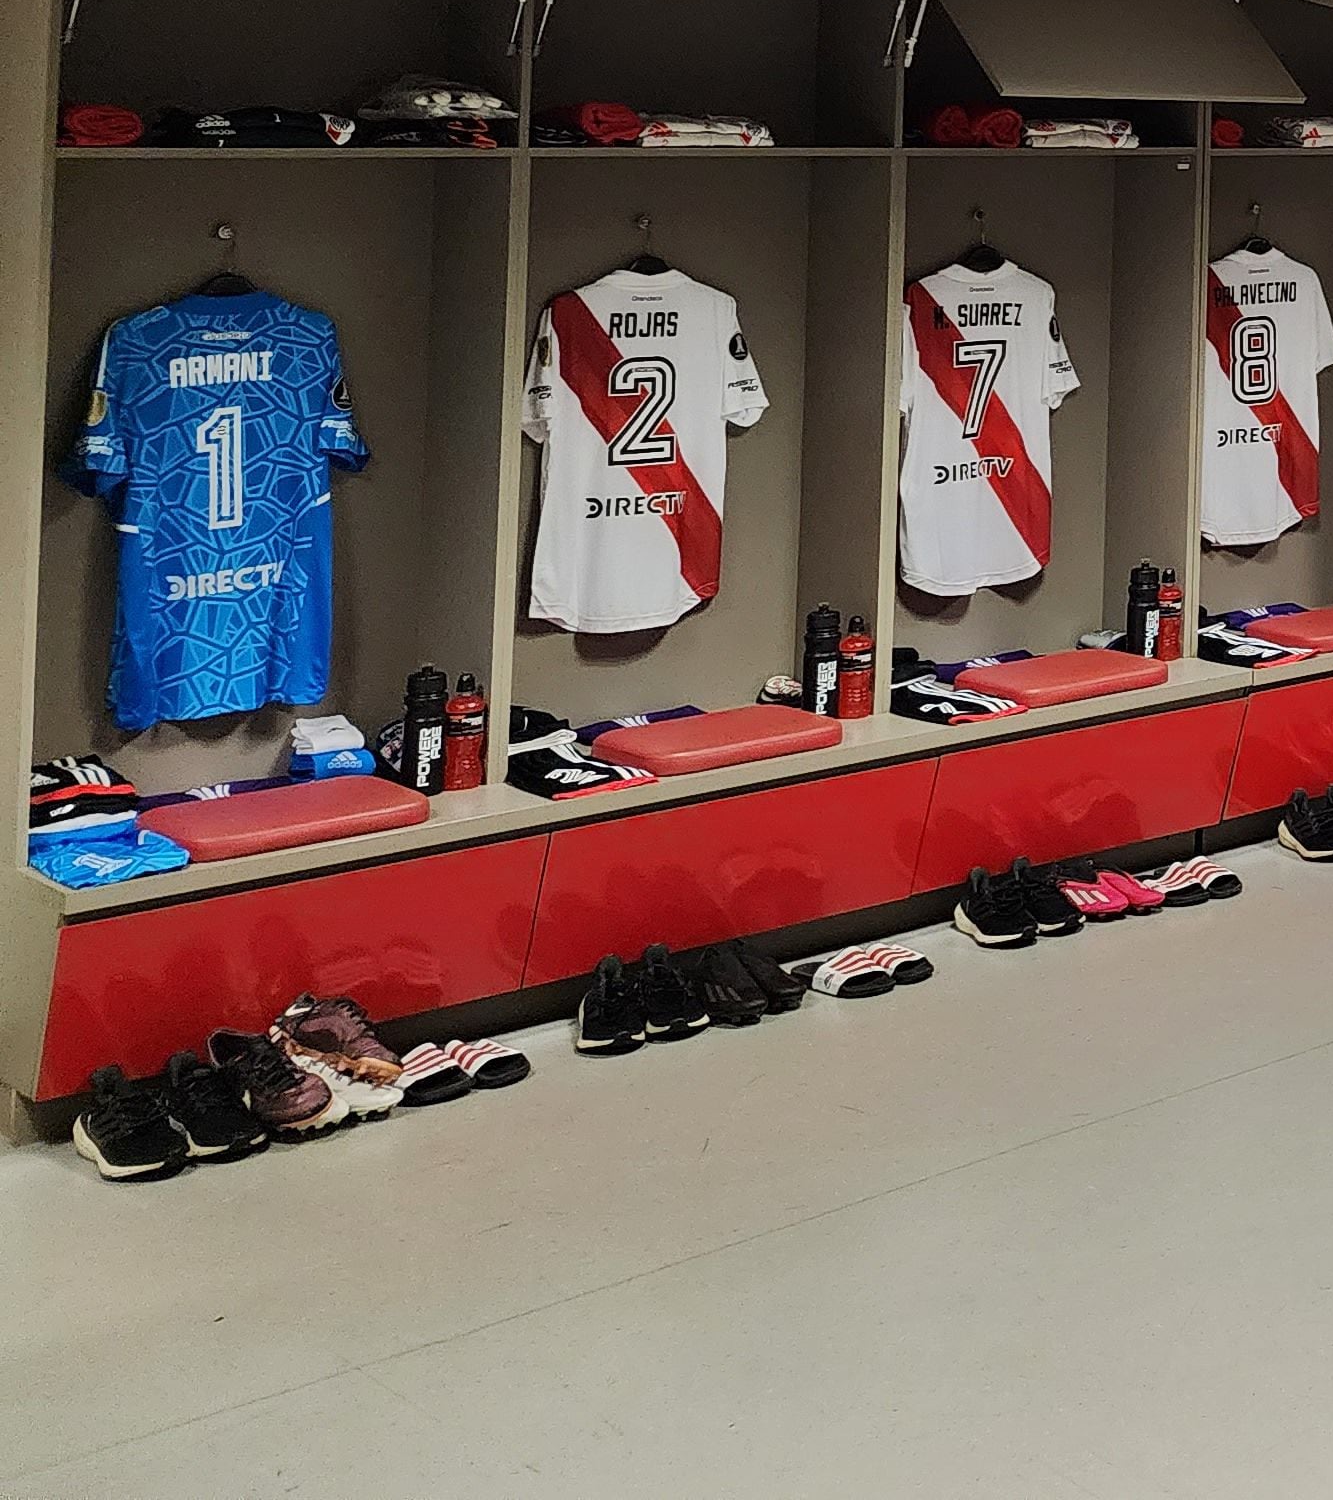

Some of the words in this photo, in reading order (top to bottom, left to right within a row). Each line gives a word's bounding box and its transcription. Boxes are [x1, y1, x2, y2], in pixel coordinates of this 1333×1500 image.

[1214, 282, 1297, 308] PALAVECINO
[609, 311, 678, 340] ROJAS
[958, 303, 1022, 328] SUAREZ
[169, 351, 273, 389] ARMANI
[1229, 315, 1278, 406] 8
[954, 339, 1007, 440] 7
[607, 356, 678, 467] 2
[196, 406, 243, 531] 1
[933, 457, 1014, 485] DIRECTV
[586, 491, 687, 519] DIRECTV
[165, 560, 286, 601] DIRECTV
[815, 661, 831, 715] POWER
[416, 726, 434, 788] POWER
[430, 724, 443, 761] ADE
[327, 761, 362, 769] adidas
